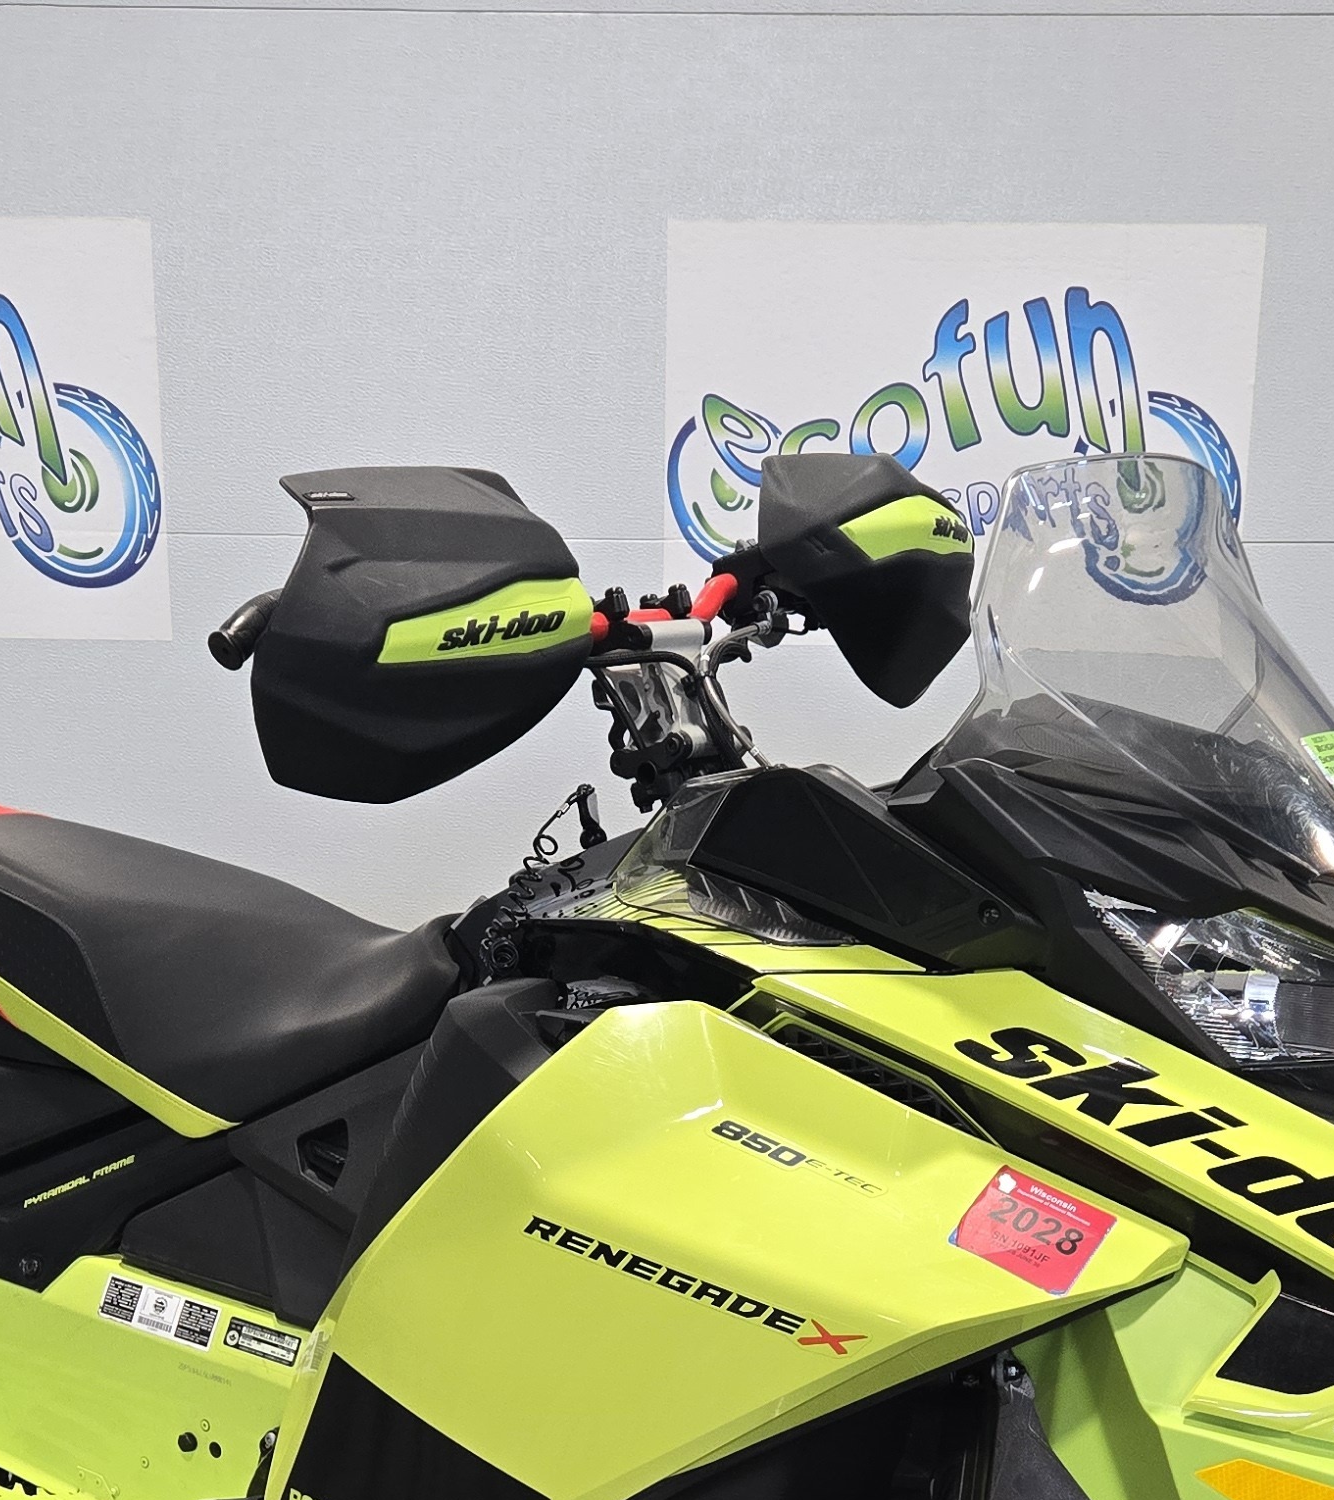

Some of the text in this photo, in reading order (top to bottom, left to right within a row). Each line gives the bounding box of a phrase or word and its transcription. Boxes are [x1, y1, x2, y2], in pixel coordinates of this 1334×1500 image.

[437, 610, 566, 651] ski-doo
[23, 1154, 136, 1209] PYRAMIDAL FRAME
[711, 1120, 882, 1194] 850 E-TEC
[1029, 1184, 1077, 1213] Wisconsin
[987, 1197, 1084, 1256] 2028
[992, 1230, 1009, 1244] SN
[523, 1215, 807, 1335] RENEGADE
